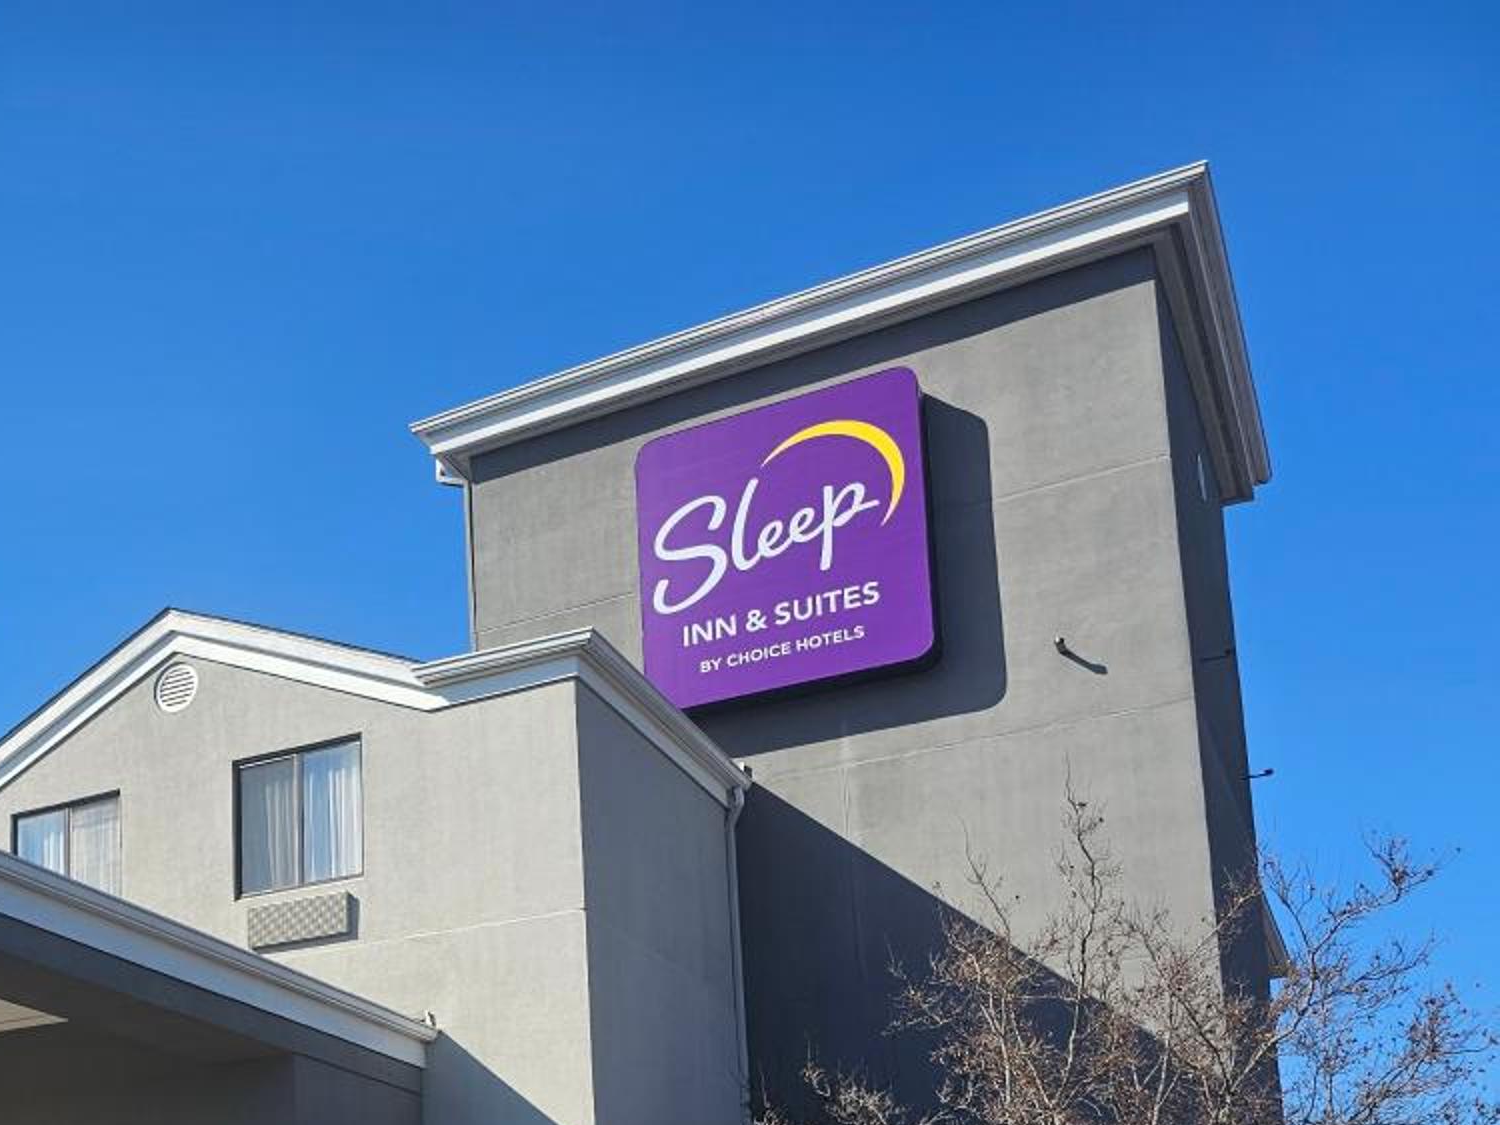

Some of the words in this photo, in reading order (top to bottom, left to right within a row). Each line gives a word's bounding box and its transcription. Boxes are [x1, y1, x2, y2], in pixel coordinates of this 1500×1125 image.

[653, 477, 880, 614] Sleep
[682, 615, 737, 647] INN
[746, 609, 767, 632] &
[774, 581, 880, 625] SUITES
[700, 658, 721, 673] BY
[727, 642, 791, 667] CHOICE
[795, 626, 865, 652] HOTELS
